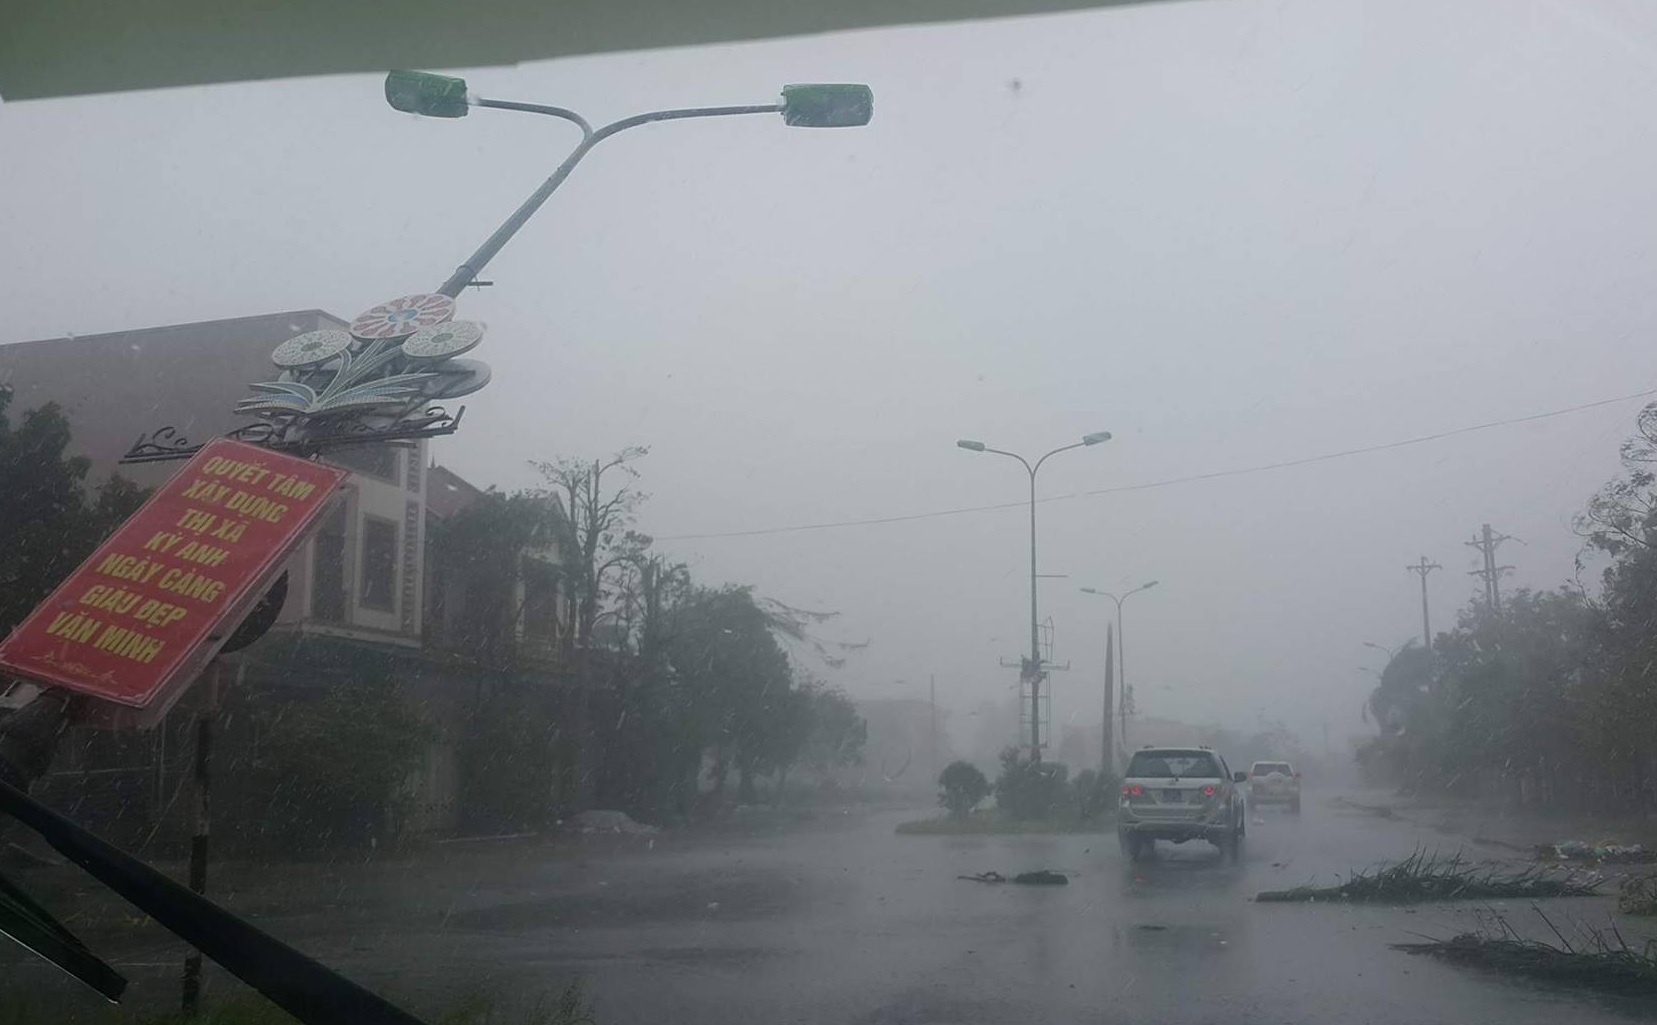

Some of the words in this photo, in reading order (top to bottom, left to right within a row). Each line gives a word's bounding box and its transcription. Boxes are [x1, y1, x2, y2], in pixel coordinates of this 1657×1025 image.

[181, 479, 231, 501] XÂY
[267, 473, 316, 501] TÂM
[176, 508, 217, 536] THỊ
[211, 519, 250, 543] XÃ
[174, 541, 231, 568] ANH
[96, 553, 165, 584] NGÀY
[158, 567, 227, 603] CÀNG
[133, 598, 188, 628] ĐẸP
[46, 610, 101, 644] VĂN
[94, 625, 166, 664] MINH
